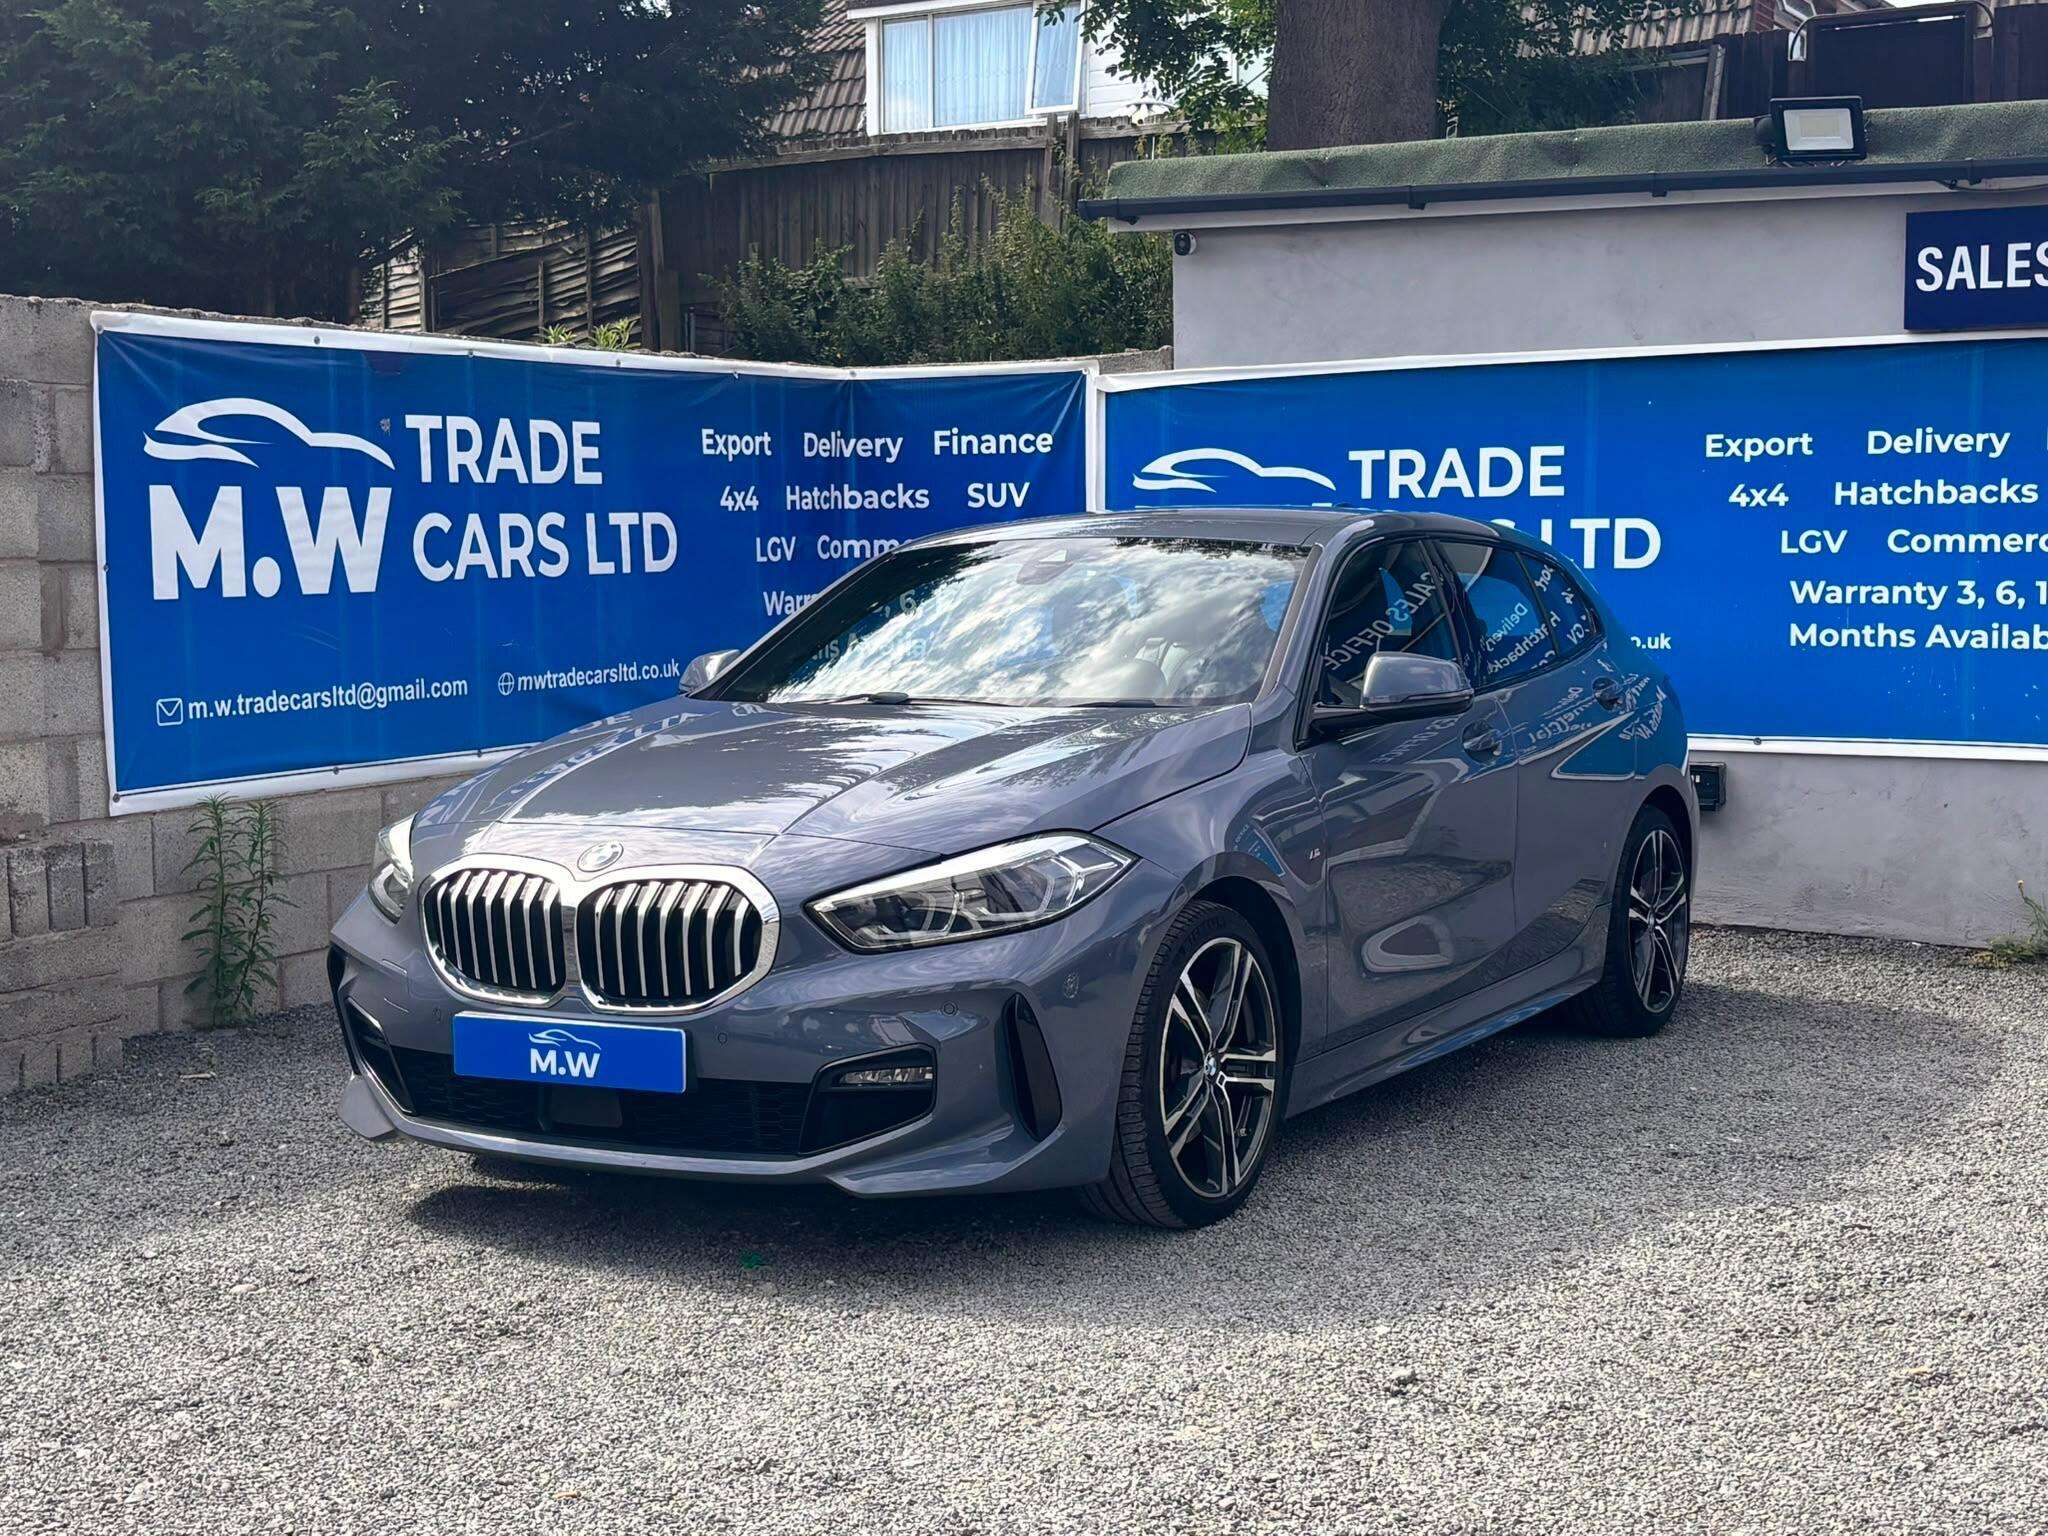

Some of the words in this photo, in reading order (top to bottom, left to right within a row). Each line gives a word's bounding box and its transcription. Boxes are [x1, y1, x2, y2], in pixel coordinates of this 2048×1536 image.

[404, 414, 603, 485] TRADE
[701, 428, 772, 462] Export
[803, 430, 904, 463] Delivery
[933, 427, 1053, 456] Finance
[1705, 432, 1813, 463] Export
[1867, 426, 2011, 459] Delivery
[1348, 445, 1565, 500] TRADE
[720, 485, 759, 512] 4x4
[786, 482, 930, 511] Hatchbacks
[967, 481, 1030, 508] SUV
[1728, 483, 1789, 508] 4x4
[1834, 477, 2039, 506] Hatchbacks
[148, 484, 392, 600] M.W
[412, 511, 570, 582] CARS
[585, 511, 678, 575] LTD
[756, 536, 796, 562] LGV
[817, 534, 913, 560] Comm
[1781, 529, 1848, 554] LGV
[763, 590, 820, 617] Warr
[1789, 580, 1949, 611] Warranty
[1956, 580, 1985, 610] 3,
[1995, 580, 2026, 610] 6,
[1790, 622, 1916, 648] Months
[517, 658, 680, 692] mwtradecarsltd.co.uk
[188, 677, 468, 720] m.w.tradecarsltd@gmail.com
[530, 1048, 601, 1079] M.W
